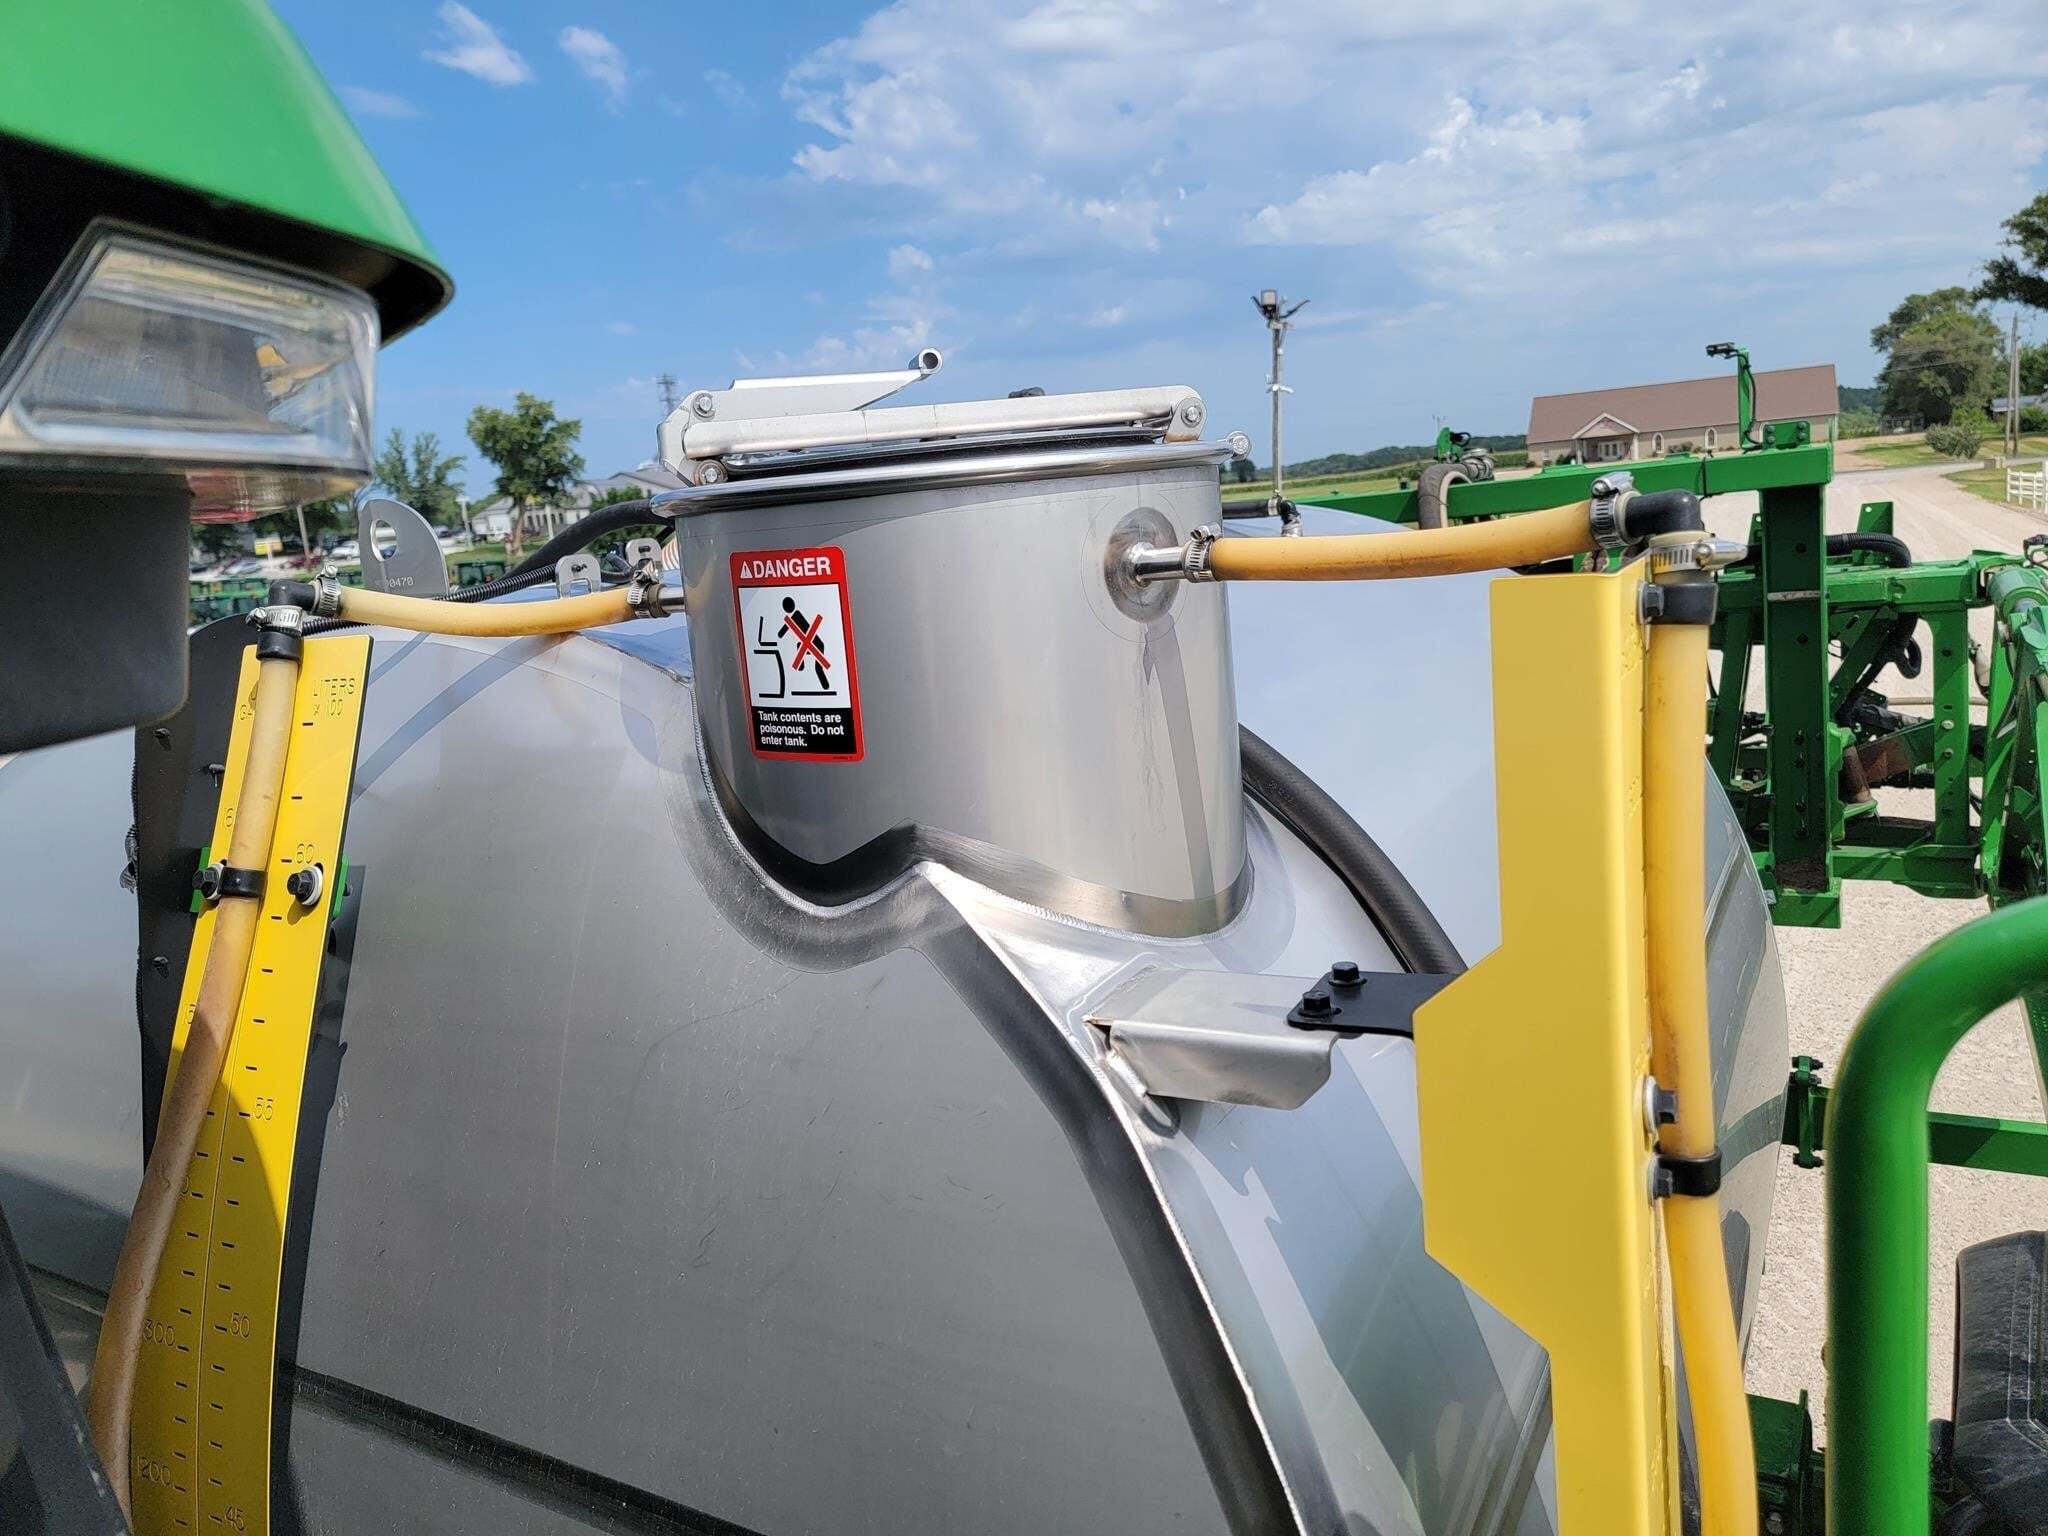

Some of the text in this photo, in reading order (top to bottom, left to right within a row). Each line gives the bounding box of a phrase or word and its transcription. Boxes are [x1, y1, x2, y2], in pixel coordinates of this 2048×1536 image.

[753, 557, 831, 578] DANGER
[313, 678, 355, 697] LITERS
[758, 711, 842, 723] Tank contents are
[760, 723, 845, 736] poisonous. Do not
[761, 736, 808, 746] enter tank.
[296, 843, 315, 864] 60
[230, 1312, 250, 1338] 50
[225, 1506, 245, 1531] 45
